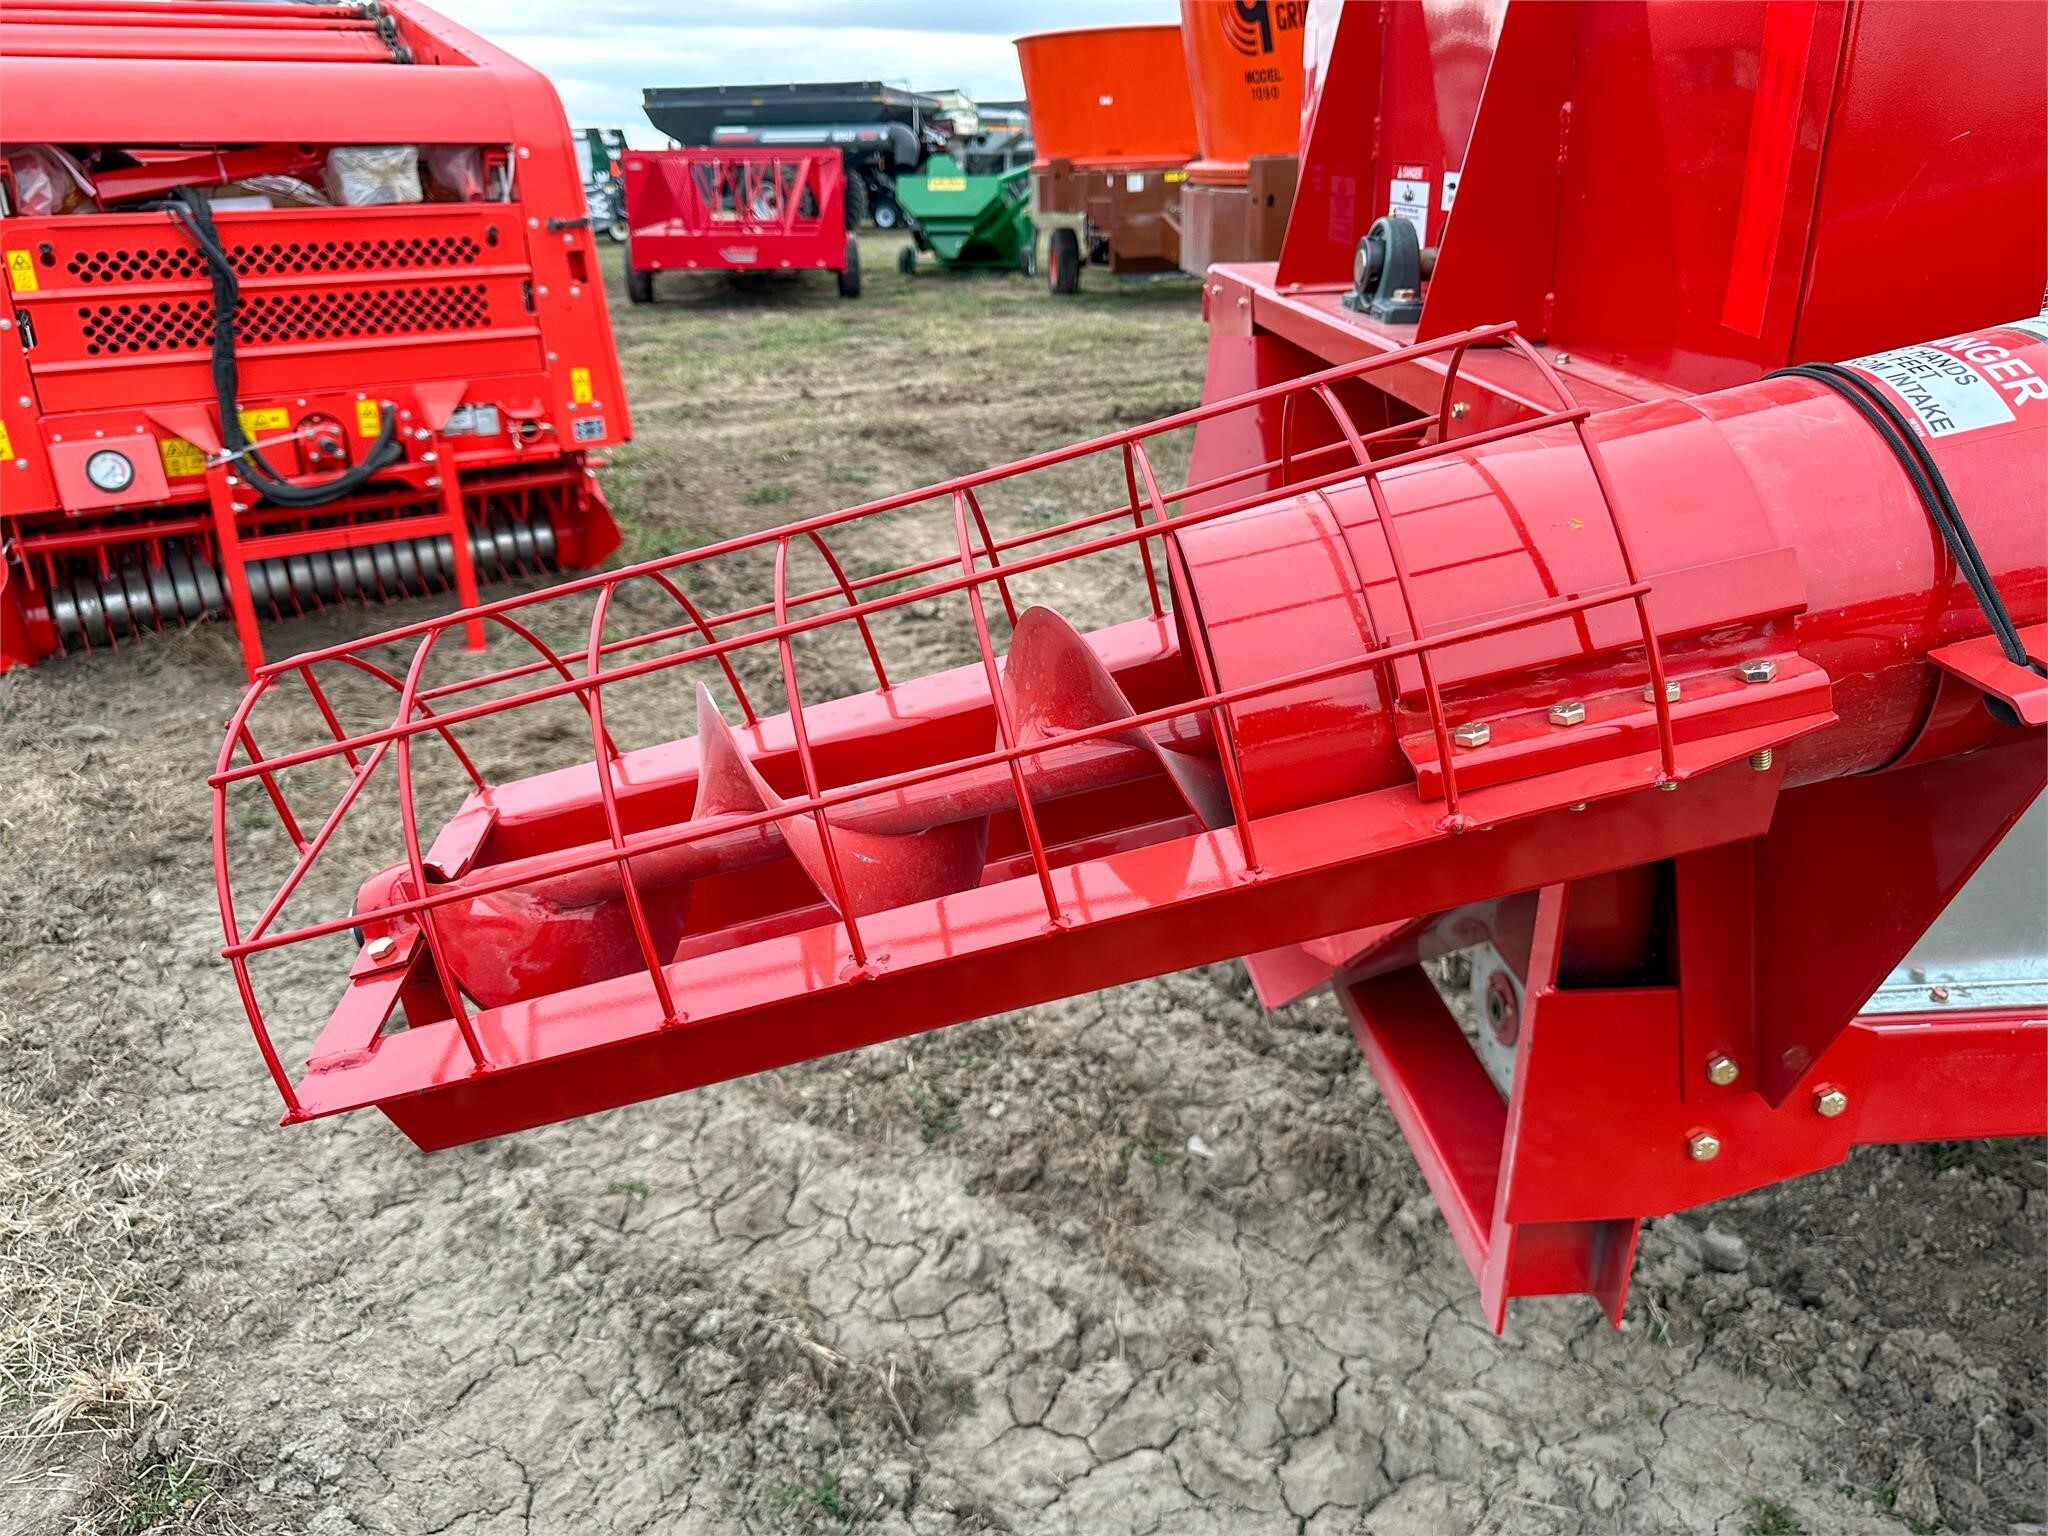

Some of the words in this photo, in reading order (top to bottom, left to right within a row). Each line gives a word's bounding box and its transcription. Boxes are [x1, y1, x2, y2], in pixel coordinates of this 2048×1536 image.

[1887, 355, 1943, 379] FEET
[1908, 348, 1979, 386] HANDS
[1885, 372, 1956, 434] INTAKE
